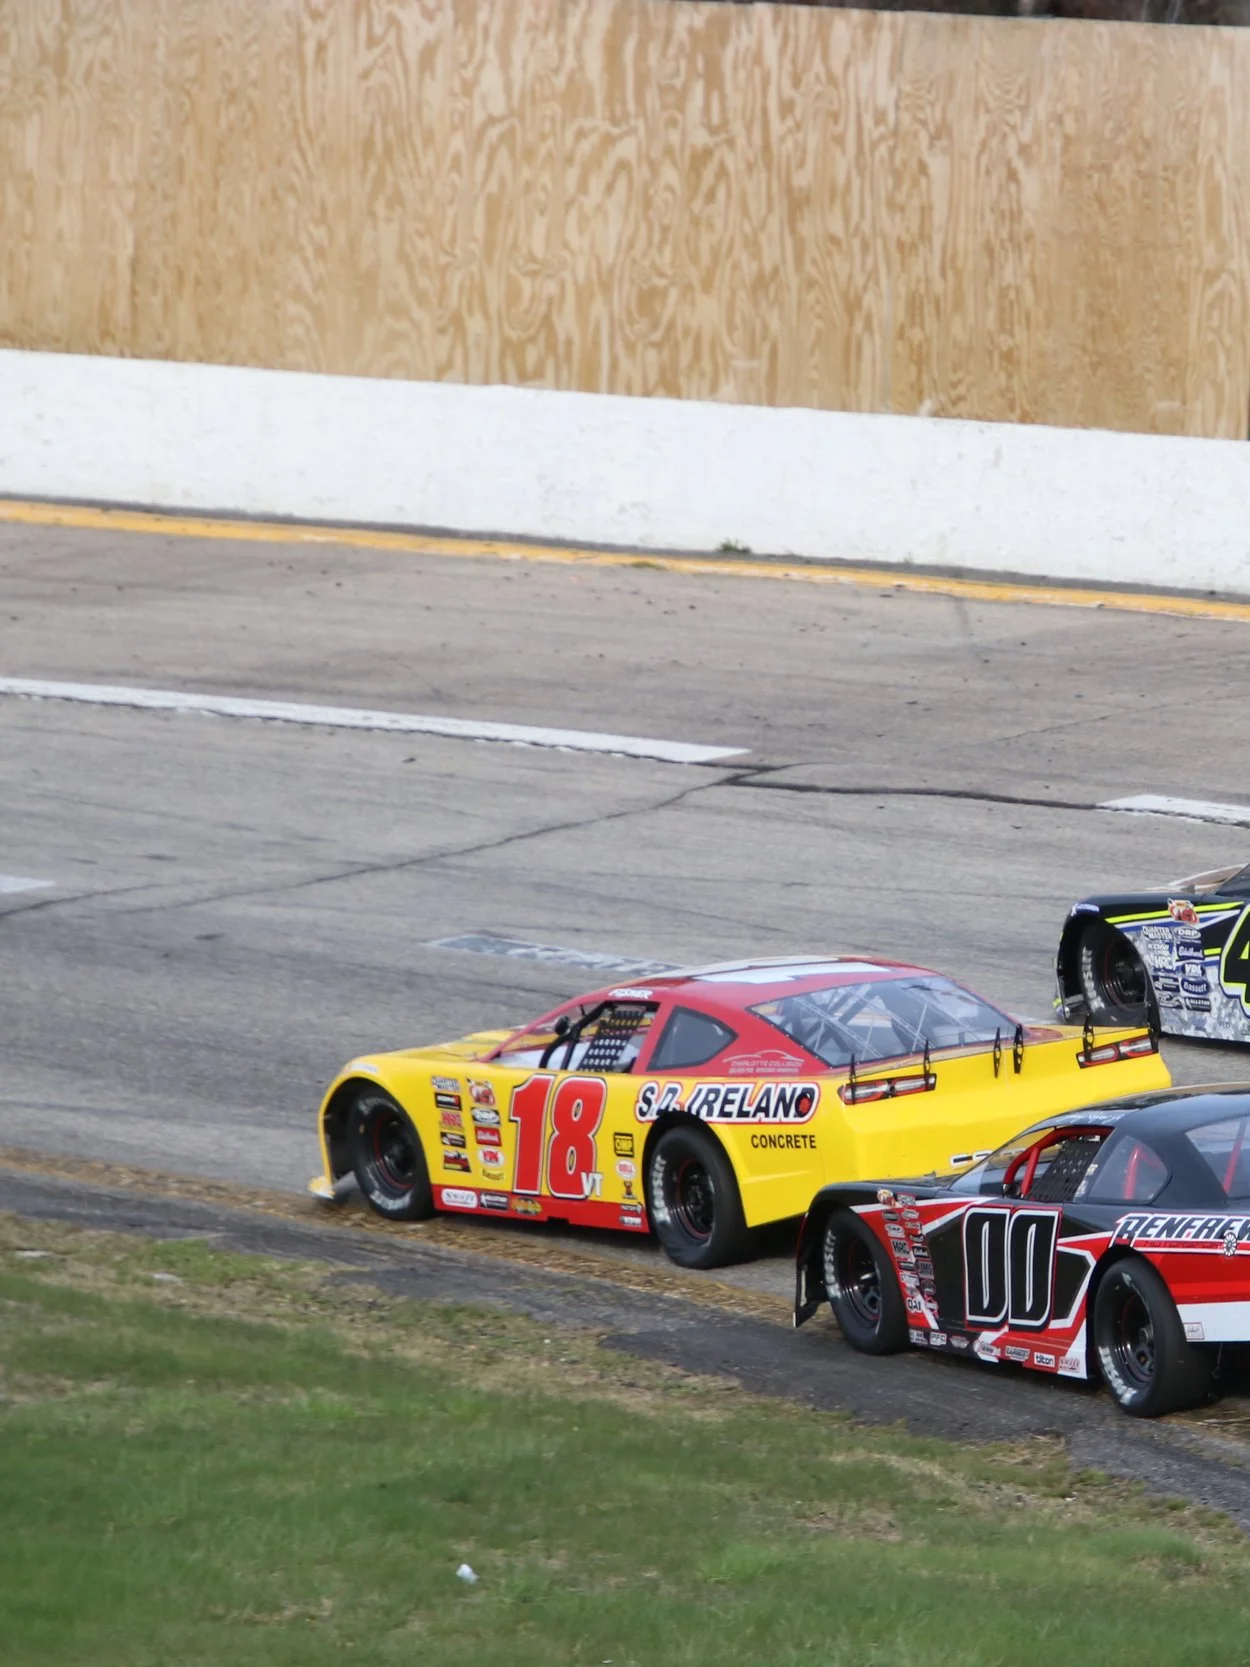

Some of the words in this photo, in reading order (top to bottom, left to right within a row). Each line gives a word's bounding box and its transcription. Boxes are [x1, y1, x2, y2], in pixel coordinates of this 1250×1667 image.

[689, 1086, 816, 1119] IRELAND
[509, 1074, 607, 1198] 18
[751, 1134, 817, 1149] CONCRETE
[581, 1172, 603, 1197] VT
